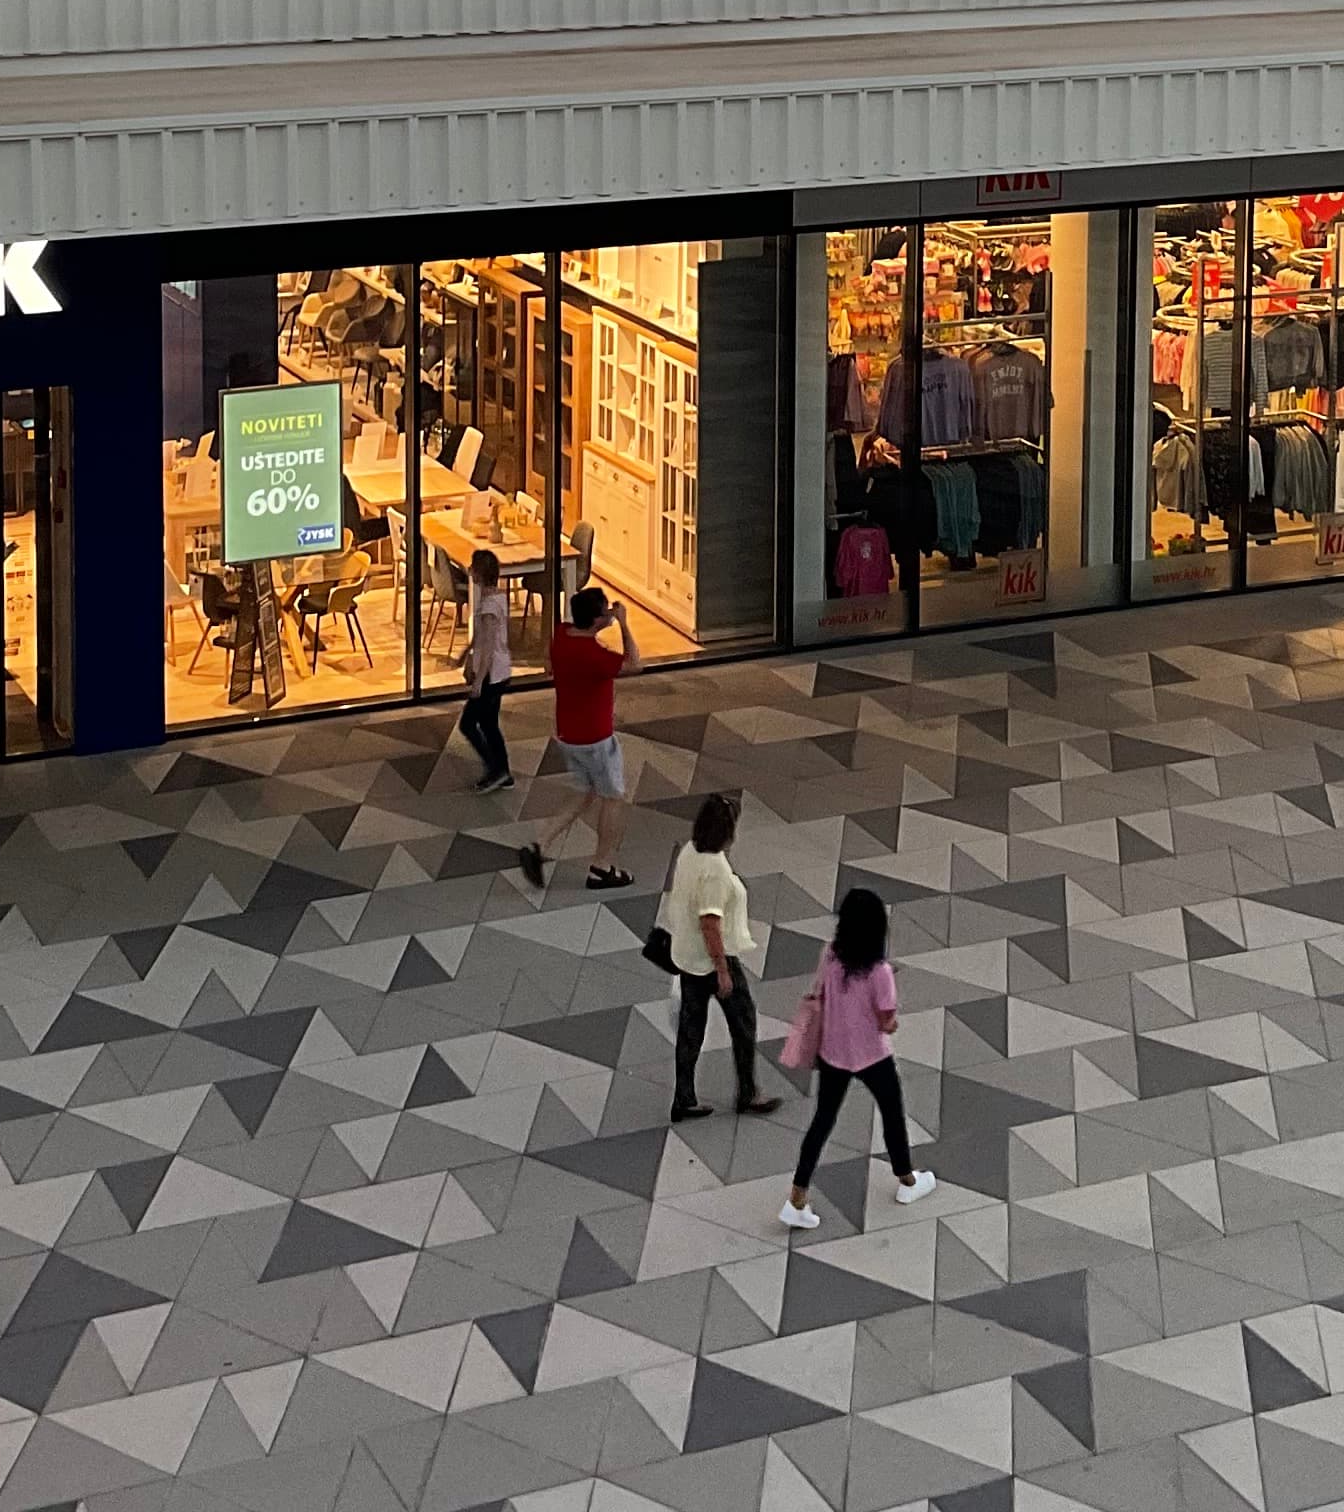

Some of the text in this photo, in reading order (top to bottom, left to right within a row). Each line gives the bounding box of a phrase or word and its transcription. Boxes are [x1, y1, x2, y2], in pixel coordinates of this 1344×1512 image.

[241, 413, 322, 435] NOVITETI
[241, 448, 325, 471] UŠTEDITE
[271, 468, 296, 486] DO
[247, 483, 320, 517] 60%
[305, 527, 334, 540] JYSK
[1004, 561, 1037, 595] kik
